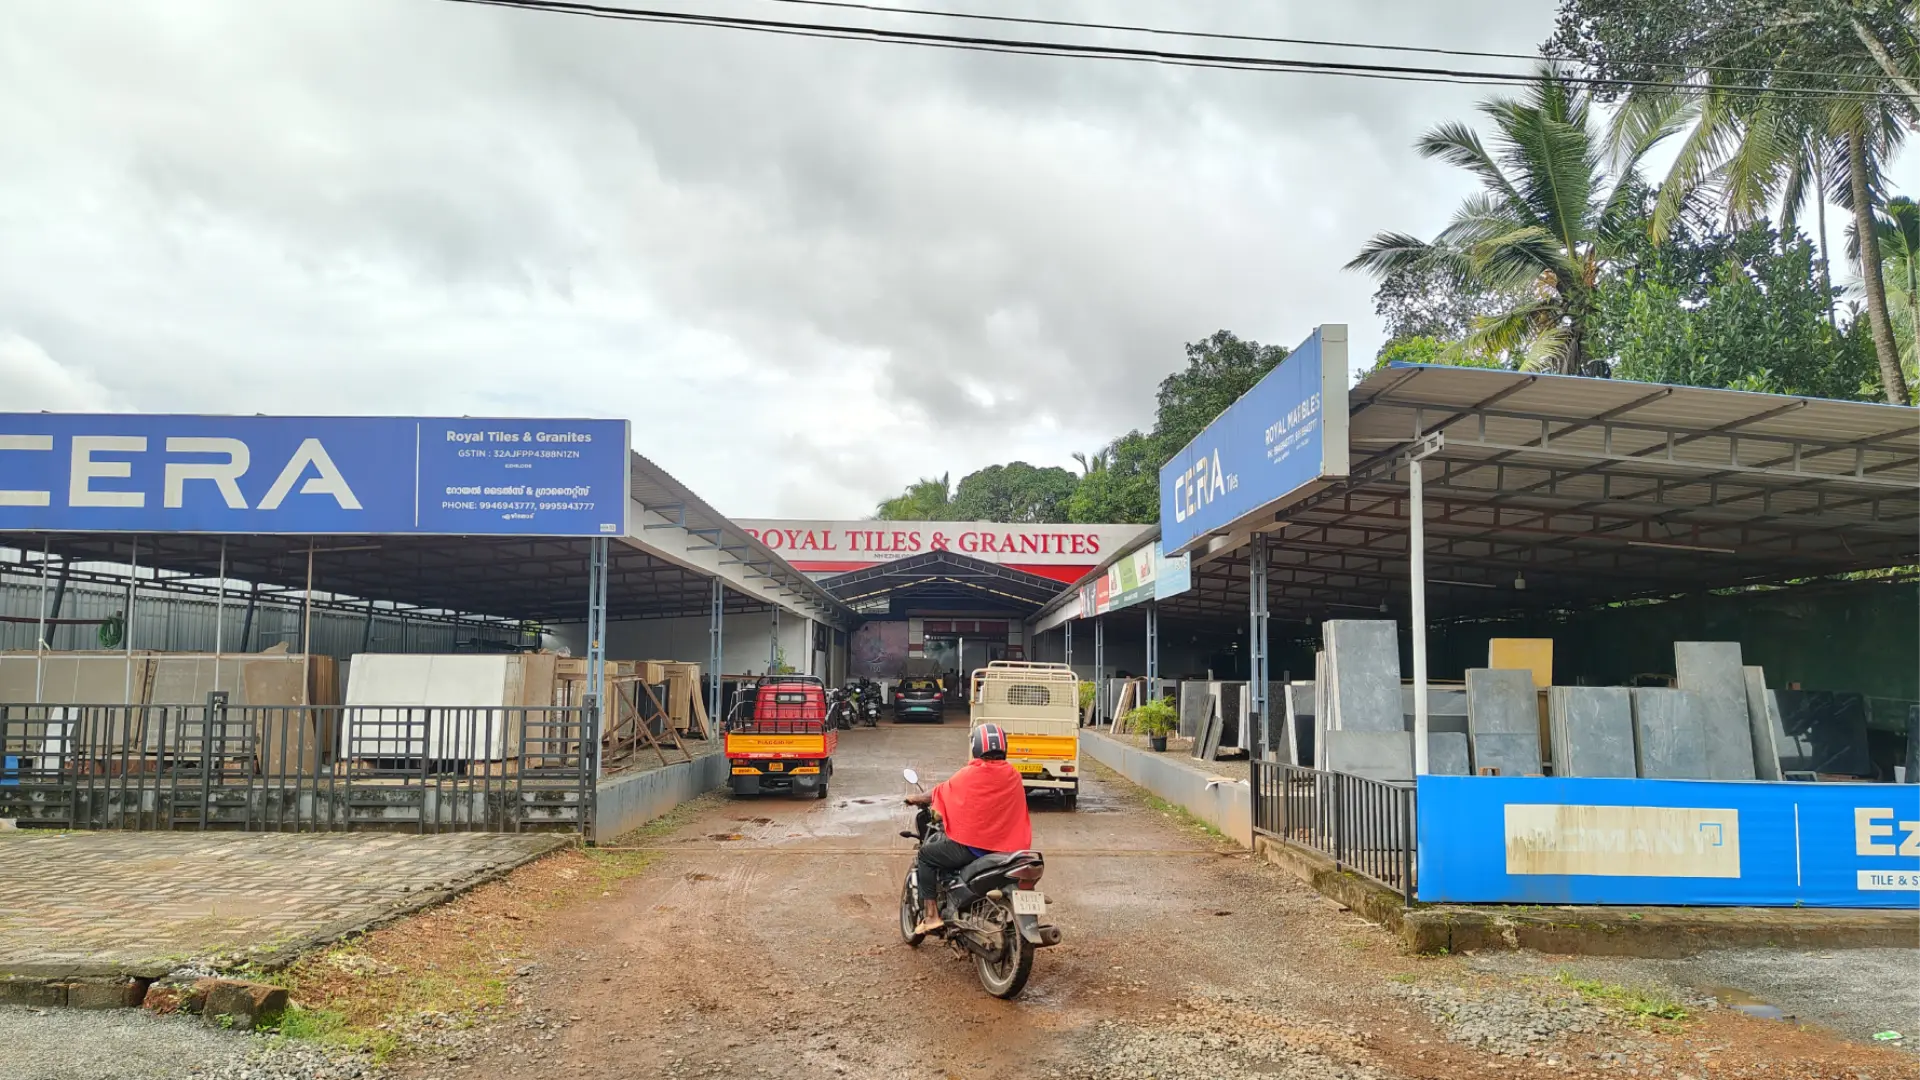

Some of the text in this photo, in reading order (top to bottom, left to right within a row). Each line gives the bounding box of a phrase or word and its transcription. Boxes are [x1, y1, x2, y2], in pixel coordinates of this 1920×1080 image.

[446, 430, 592, 444] Royal Tiles & Granites
[1265, 416, 1287, 446] ROYAL
[458, 450, 486, 458] GSTIN
[526, 486, 535, 496] &
[1175, 447, 1226, 524] CERA
[1226, 473, 1239, 493] Tiles
[441, 501, 477, 510] PHONE:
[539, 502, 595, 511] 9995943777
[845, 531, 921, 551] TILES
[930, 532, 950, 552] &
[958, 532, 1101, 554] GRANITES
[1870, 875, 1893, 886] TILE
[1898, 875, 1908, 886] &
